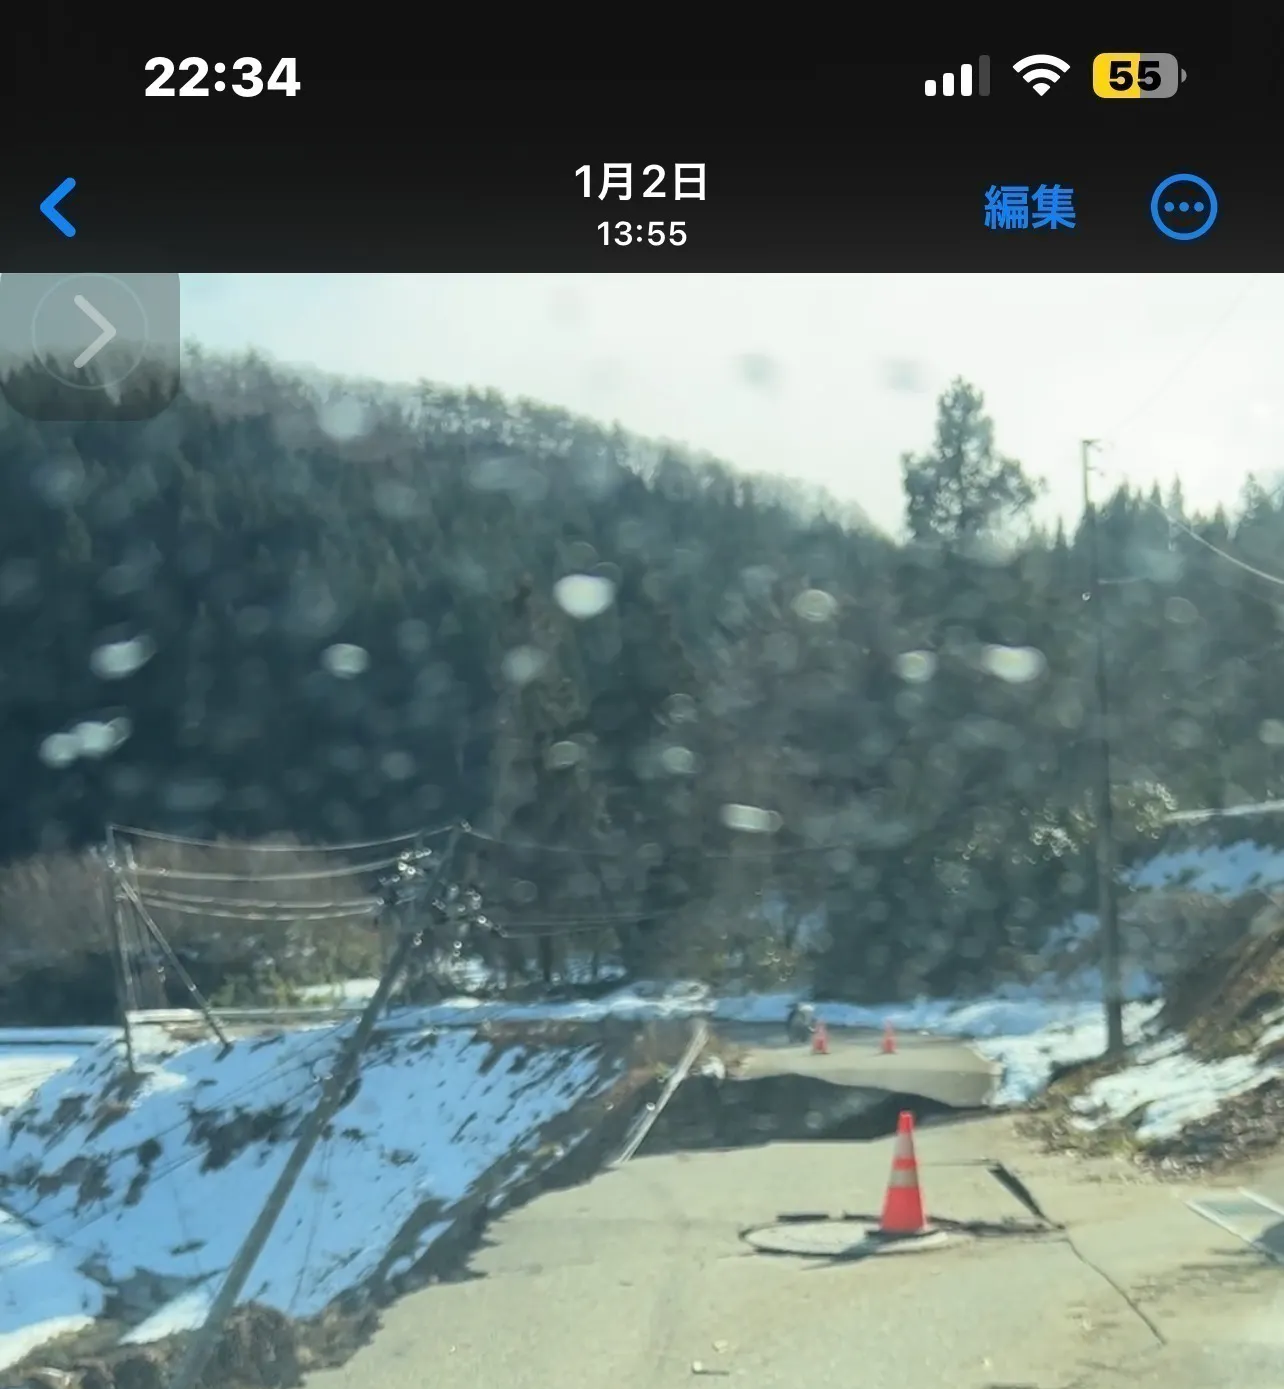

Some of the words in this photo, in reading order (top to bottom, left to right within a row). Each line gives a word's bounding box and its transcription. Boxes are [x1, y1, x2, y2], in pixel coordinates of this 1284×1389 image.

[144, 57, 301, 98] 22:34
[1109, 61, 1162, 91] 55
[575, 162, 706, 201] 1月2日
[983, 183, 1077, 230] 編集
[597, 220, 688, 247] 13:55
